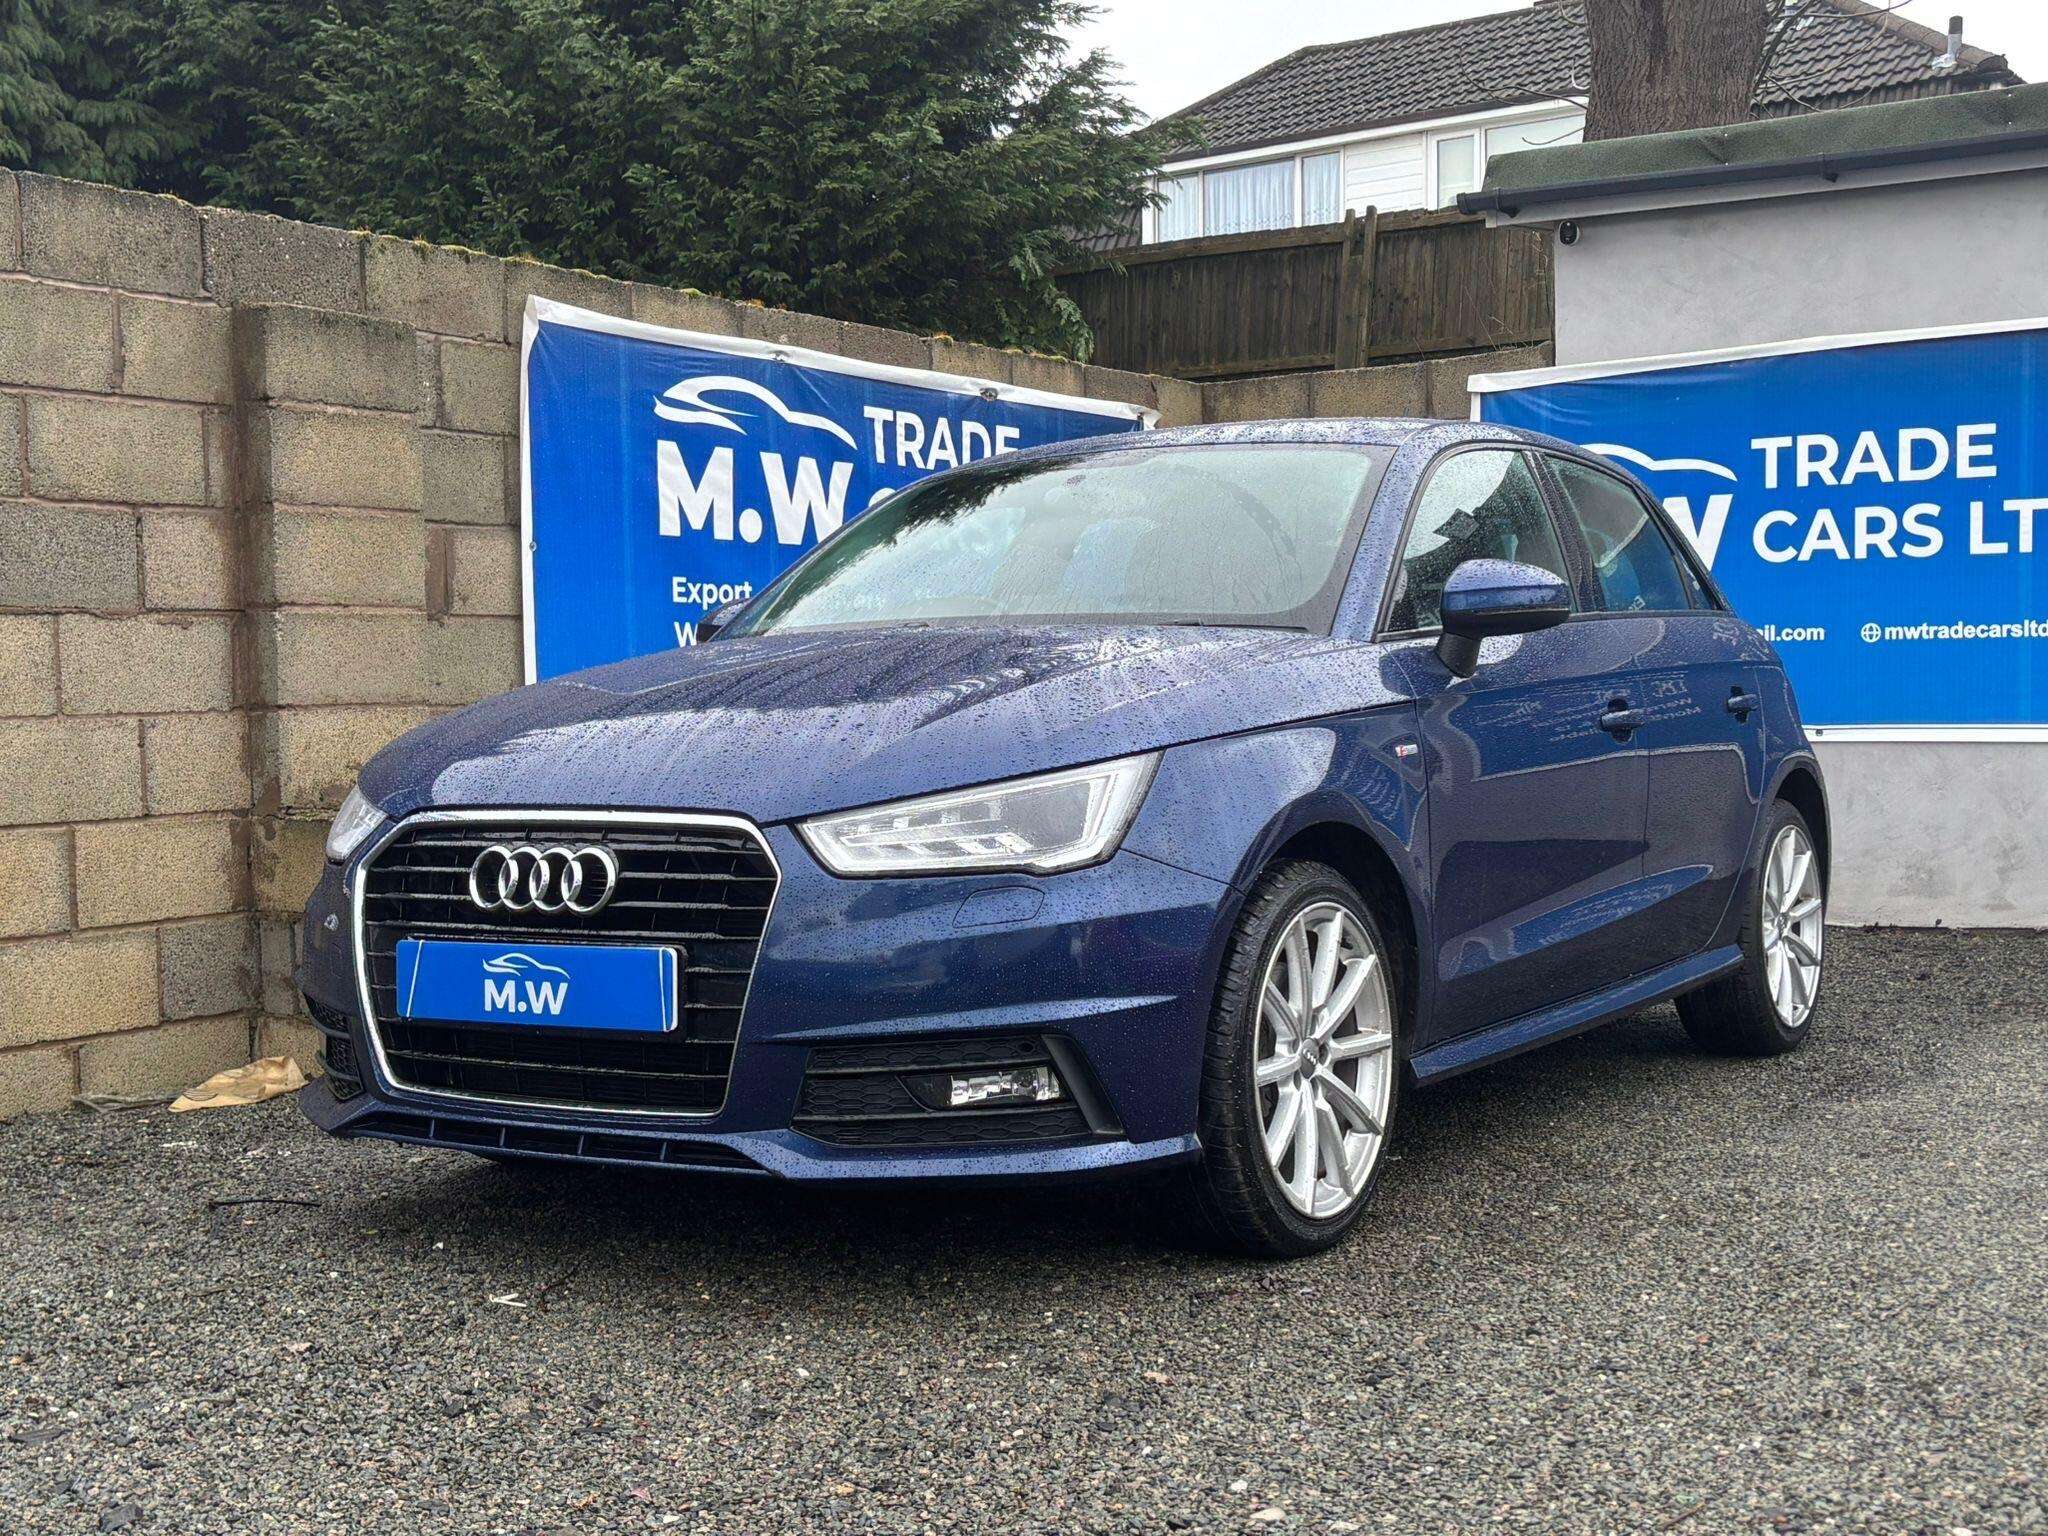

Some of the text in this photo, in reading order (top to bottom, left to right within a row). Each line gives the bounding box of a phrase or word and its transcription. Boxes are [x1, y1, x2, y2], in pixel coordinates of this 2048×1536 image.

[1750, 422, 1998, 489] TRADE
[657, 439, 854, 545] M.W
[1752, 502, 1944, 563] CARS
[1969, 497, 2048, 555] LT
[672, 576, 752, 611] Export
[1884, 619, 2048, 640] mwtradecarsltd
[484, 979, 569, 1015] M.W
